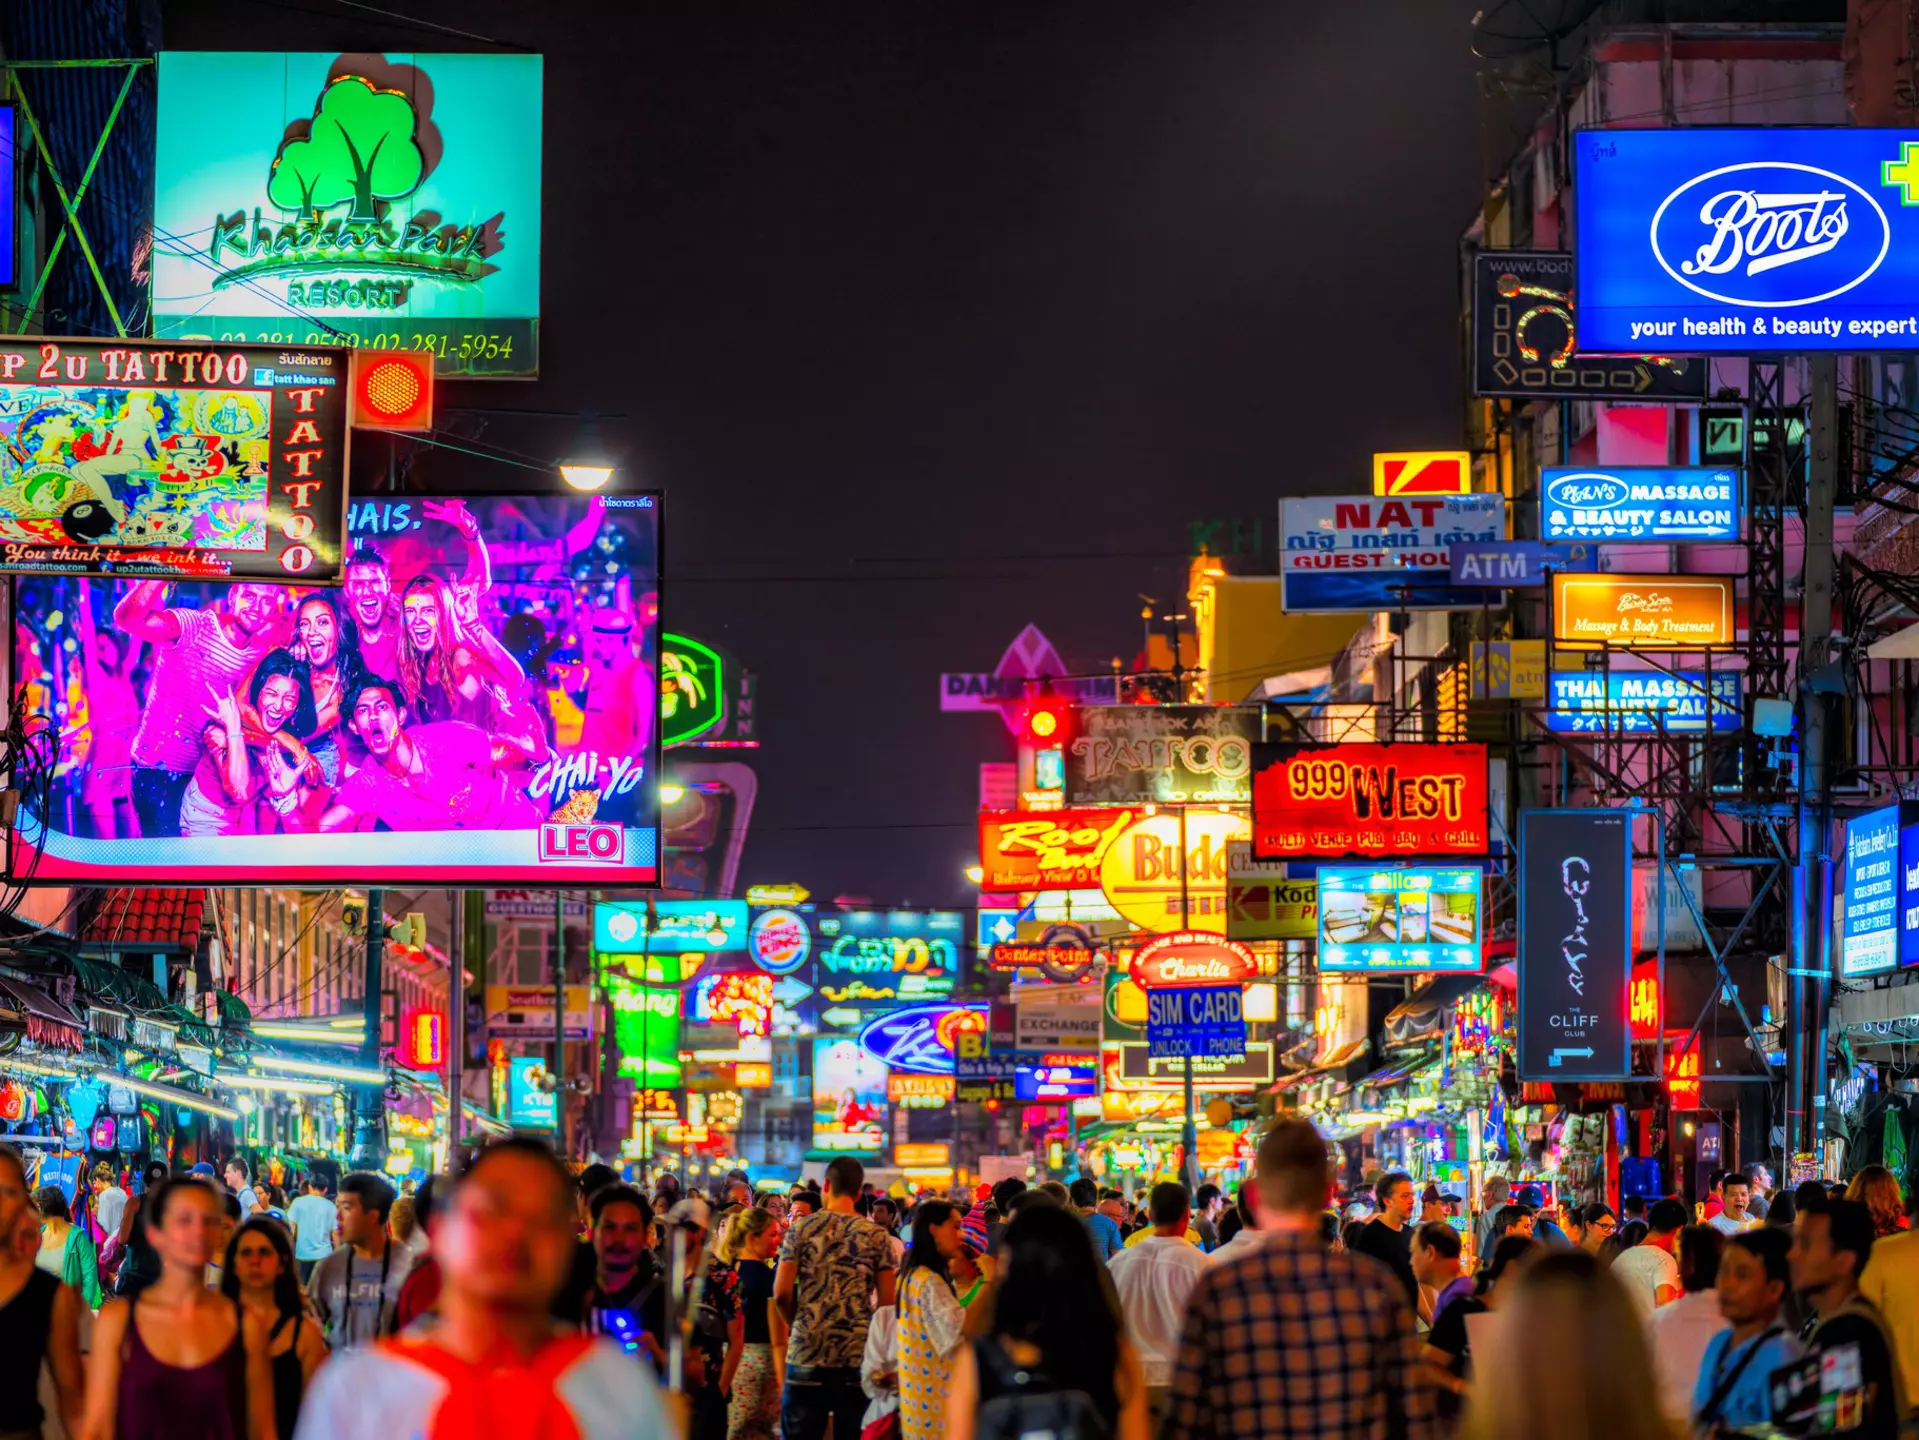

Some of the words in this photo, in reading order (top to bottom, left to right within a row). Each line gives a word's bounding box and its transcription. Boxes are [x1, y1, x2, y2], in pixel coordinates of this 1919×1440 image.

[212, 213, 394, 264] Khaosan
[399, 221, 486, 260] Park
[1681, 190, 1849, 276] Boots
[289, 285, 402, 307] RESORT
[1630, 318, 1677, 339] your
[1683, 316, 1746, 336] health
[1752, 318, 1768, 335] &
[1773, 316, 1843, 338] beauty
[1848, 317, 1917, 338] expert
[101, 349, 249, 385] TATTOO
[293, 373, 318, 385] khao
[318, 376, 336, 385] san
[277, 386, 326, 573] TATTOO
[1630, 485, 1731, 500] MASSAGE
[1335, 500, 1445, 529] NAT
[1549, 510, 1567, 525] &
[1573, 510, 1655, 525] BEAUTY
[1659, 510, 1731, 525] SALON
[1286, 530, 1336, 553] ณัฐ
[4, 544, 48, 564] You
[52, 547, 100, 562] think
[106, 549, 121, 562] it
[167, 549, 197, 564] ink
[1293, 553, 1385, 568] GUEST
[1460, 553, 1527, 579] ATM
[1574, 618, 1618, 635] Massage
[1619, 617, 1630, 633] &
[1633, 618, 1659, 636] Body
[1661, 618, 1716, 633] Treatment
[1621, 680, 1736, 697] MASSAGE
[1667, 699, 1736, 715] SALON
[1071, 735, 1251, 782] TATTOO
[1289, 760, 1348, 799] 999
[1350, 764, 1466, 820] WEST
[544, 826, 620, 860] LEO
[998, 810, 1133, 858] Roof
[1265, 833, 1305, 849] MULTI
[1310, 833, 1352, 848] VENUE
[1357, 831, 1385, 847] PUB
[1393, 832, 1420, 849] BBQ
[1445, 831, 1481, 847] GRILL
[1373, 871, 1433, 890] Pillow
[759, 937, 801, 957] KING
[1173, 934, 1193, 944] AND
[994, 946, 1047, 963] Center
[1050, 946, 1092, 963] Point
[1159, 956, 1230, 980] Charlie
[1149, 993, 1183, 1025] SIM
[1189, 991, 1243, 1024] CARD
[1020, 1020, 1100, 1031] EXCHANGE
[1550, 1014, 1599, 1027] CLIFF
[1150, 1038, 1192, 1055] UNLOCK
[1209, 1037, 1244, 1053] PHONE
